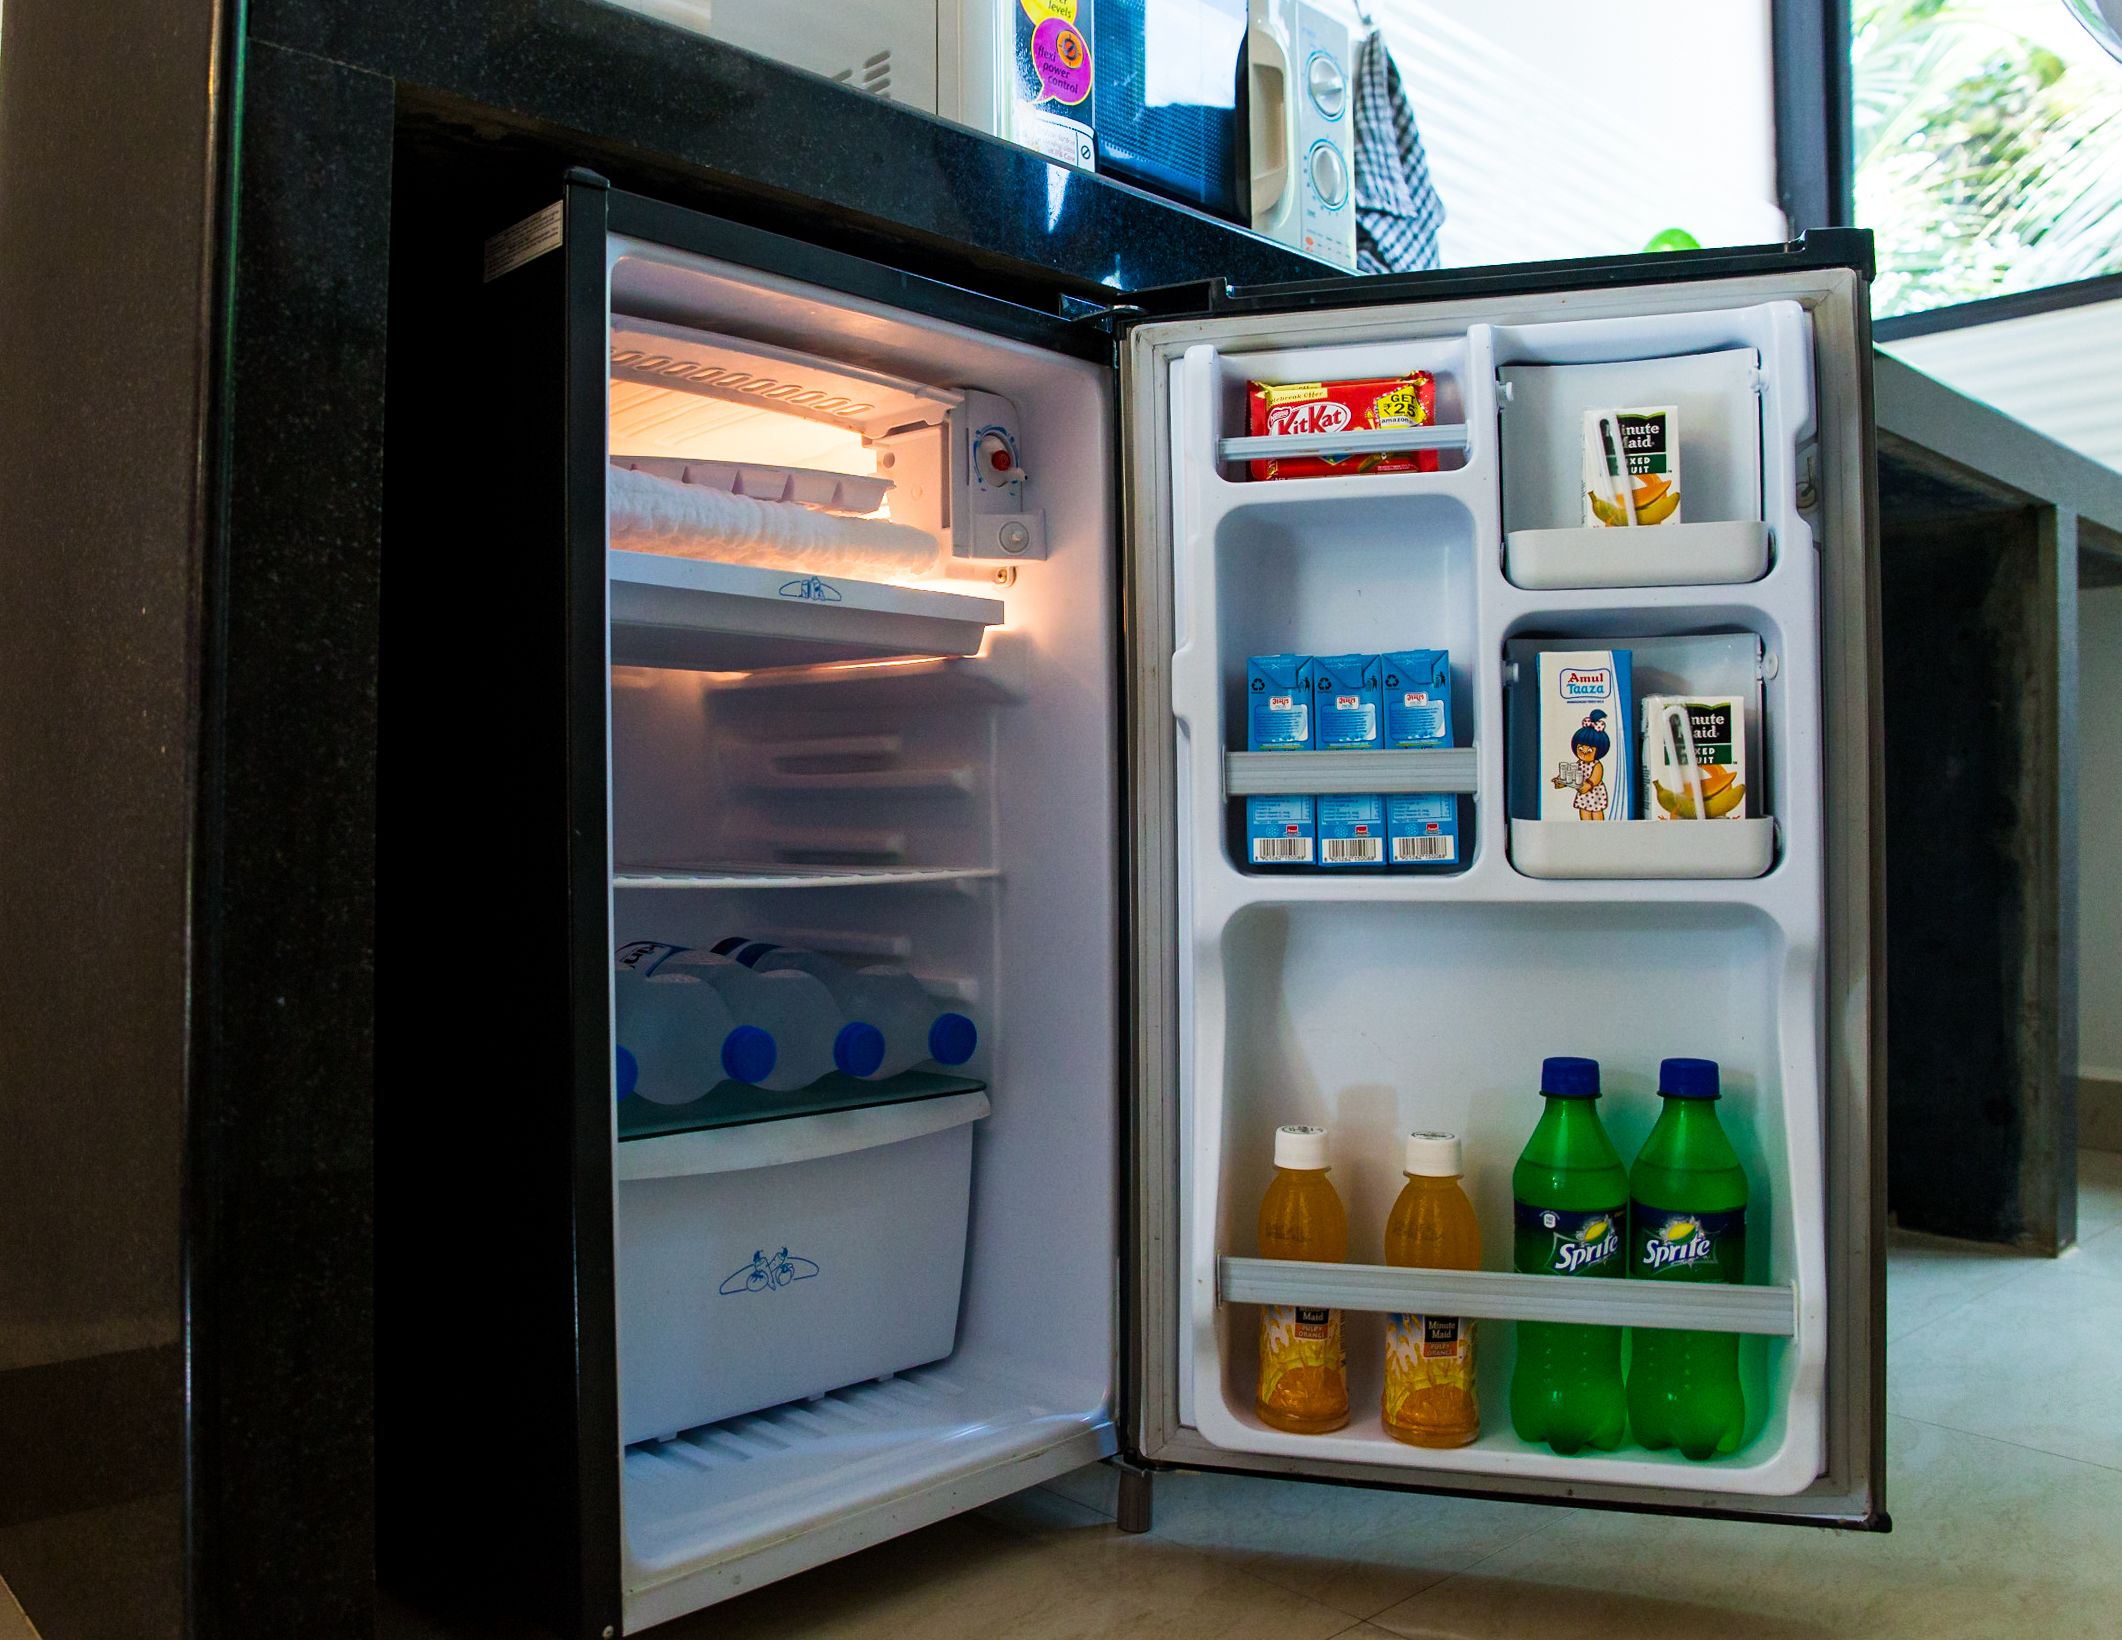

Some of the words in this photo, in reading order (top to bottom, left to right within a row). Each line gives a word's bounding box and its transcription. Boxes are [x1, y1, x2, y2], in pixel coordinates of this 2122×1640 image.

[1048, 0, 1072, 18] levels
[1038, 45, 1056, 61] flexi
[1043, 62, 1070, 79] power
[1047, 76, 1078, 93] control
[1304, 391, 1323, 399] Offer
[1390, 394, 1415, 405] GET
[1629, 457, 1651, 466] XED
[1630, 465, 1650, 474] UIT
[1568, 672, 1604, 683] Amul
[1566, 683, 1604, 695] Taaza
[1690, 713, 1725, 725] nute
[1693, 725, 1718, 738] aid
[1695, 747, 1716, 755] XED
[1555, 1233, 1618, 1272] Sprite
[1642, 1234, 1711, 1268] Sprite
[1302, 1311, 1324, 1321] Maid
[1428, 1320, 1456, 1330] Minute
[1431, 1329, 1452, 1339] Maid
